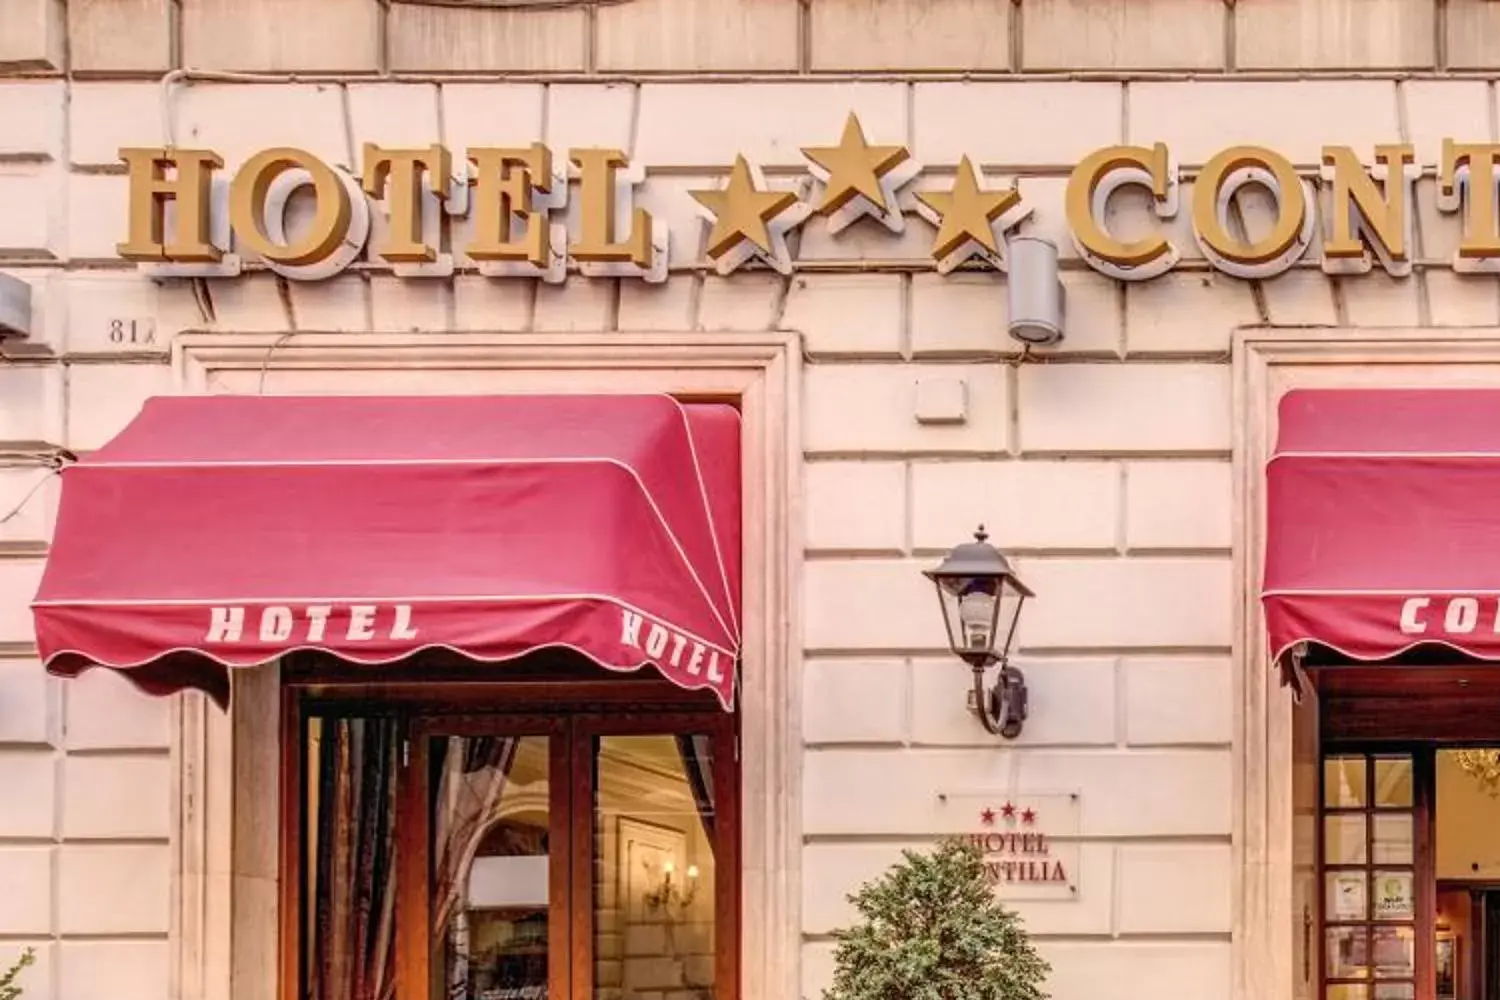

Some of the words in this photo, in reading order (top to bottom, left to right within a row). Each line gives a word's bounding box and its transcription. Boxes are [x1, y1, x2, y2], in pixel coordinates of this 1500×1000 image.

[117, 142, 653, 268] HOTEL
[204, 604, 419, 642] HOTEL
[620, 609, 724, 683] HOTEL
[969, 833, 1048, 854] HOTEL
